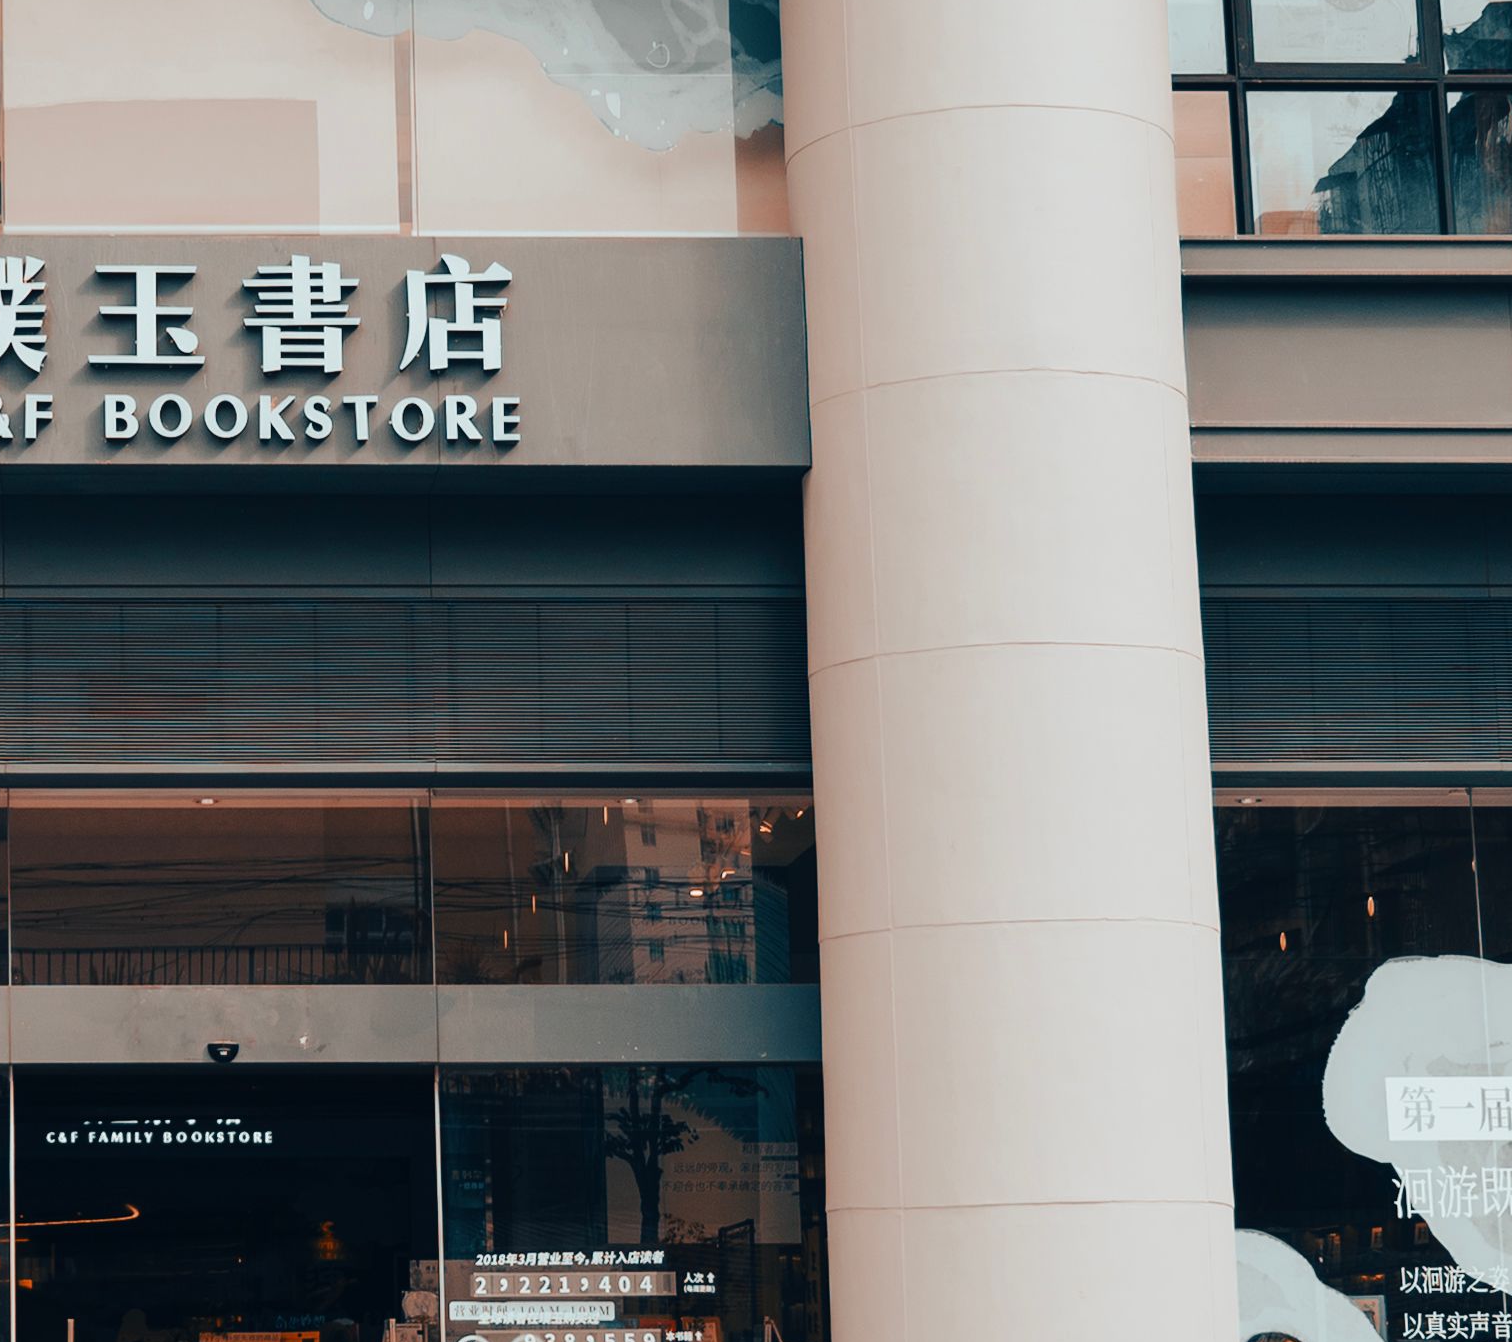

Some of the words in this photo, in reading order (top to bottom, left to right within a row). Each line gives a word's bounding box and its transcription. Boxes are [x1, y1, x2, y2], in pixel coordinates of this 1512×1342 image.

[104, 394, 522, 442] BOOKSTORE
[46, 1130, 79, 1144] C&F
[88, 1130, 154, 1144] FAMILY
[163, 1130, 273, 1144] BOOKSTORE
